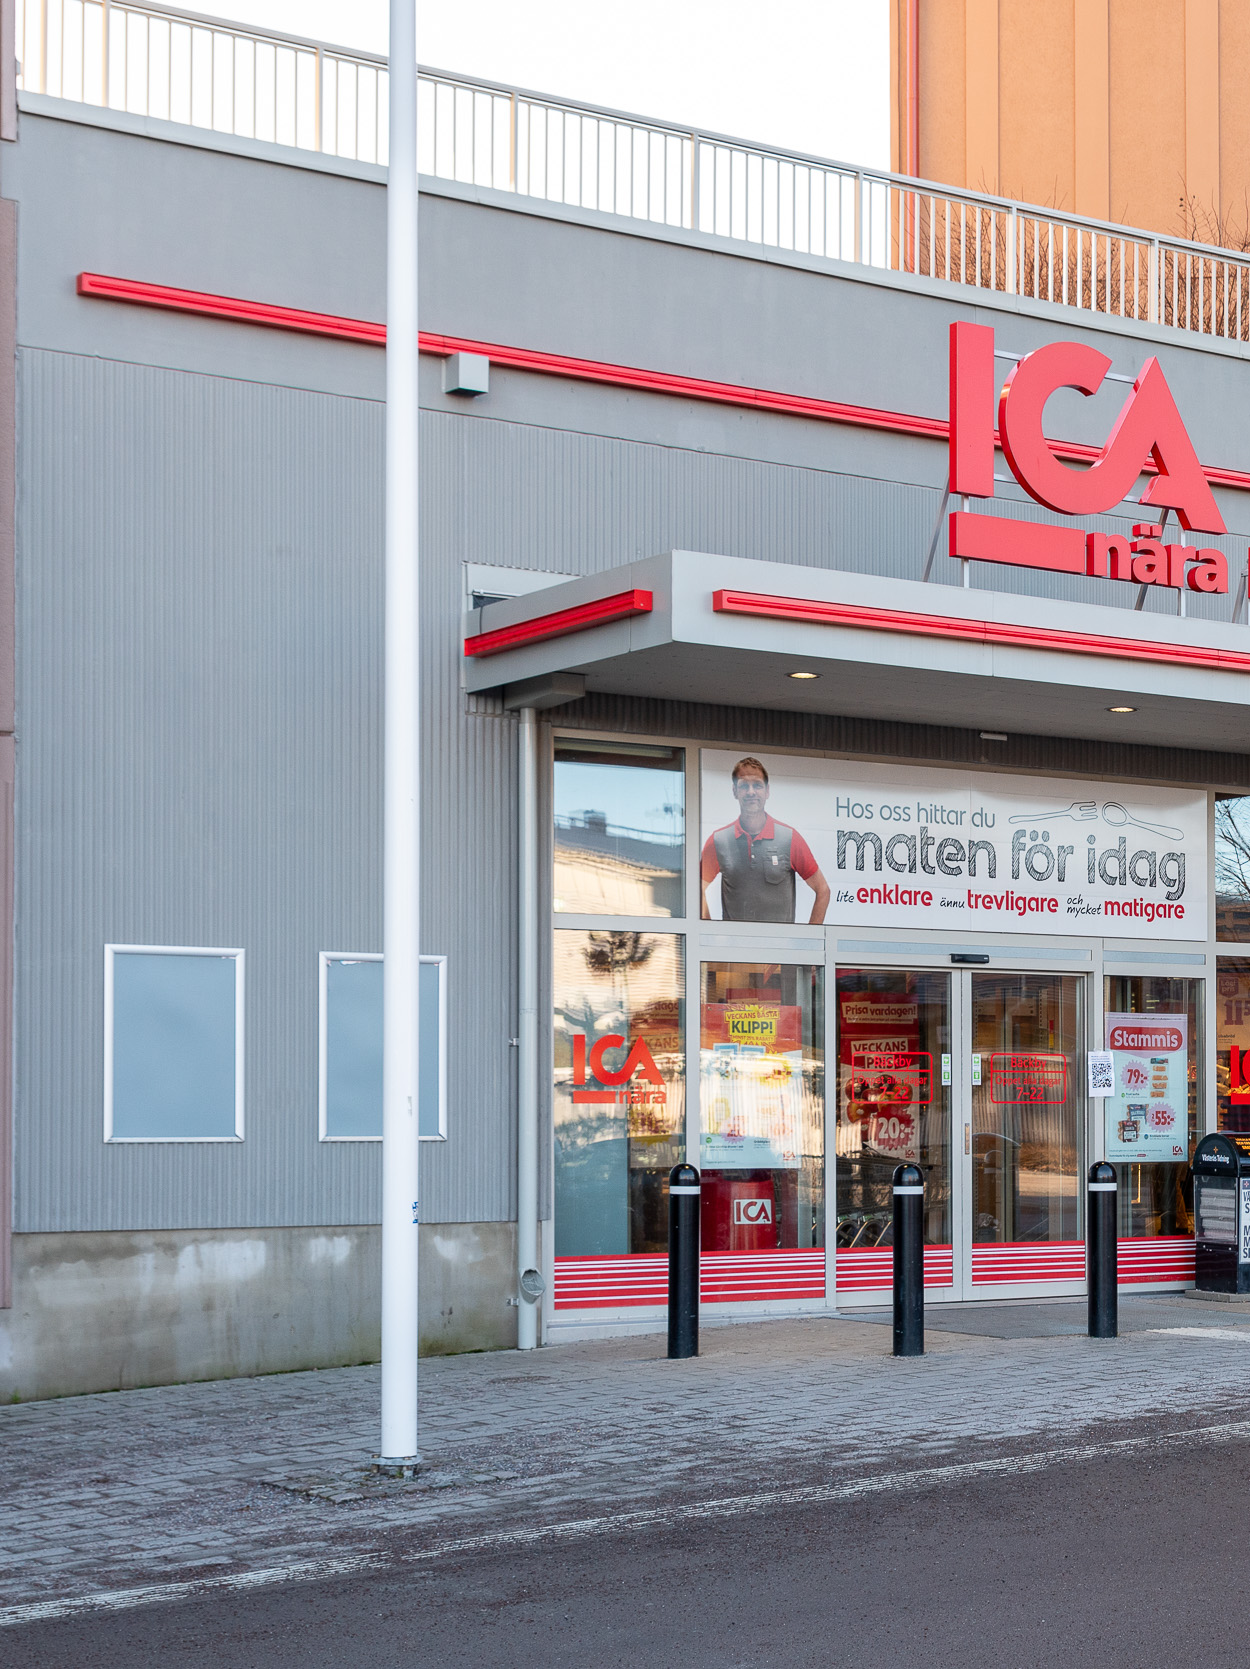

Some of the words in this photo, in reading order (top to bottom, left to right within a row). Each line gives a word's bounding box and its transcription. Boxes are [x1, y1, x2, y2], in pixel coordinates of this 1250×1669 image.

[950, 322, 1227, 533] ICA
[1086, 525, 1229, 594] nära
[836, 797, 875, 820] Hos
[879, 805, 912, 823] oss
[916, 802, 966, 826] hittar
[971, 806, 996, 828] du
[836, 826, 997, 879] maten
[1011, 829, 1074, 882] för
[1086, 834, 1186, 901] idag
[836, 889, 854, 904] lite
[856, 883, 933, 906] enklare
[940, 896, 965, 909] ännu
[967, 889, 1059, 916] trevligare
[1067, 894, 1084, 905] och
[1066, 903, 1102, 918] mycket
[1104, 898, 1185, 922] matigare
[726, 1012, 756, 1020] VECKANS
[845, 1005, 868, 1015] Prisa
[869, 1005, 916, 1018] vardagen!
[732, 1020, 773, 1034] KLIPP!
[853, 1041, 906, 1053] VECKANS
[1114, 1029, 1179, 1048] Stammis
[573, 1034, 666, 1086] ICA
[873, 1054, 912, 1071] Bäckby
[1010, 1057, 1047, 1071] Bäckby
[857, 1074, 887, 1087] Öppet
[887, 1075, 902, 1085] alla
[902, 1075, 928, 1087] dagar
[995, 1074, 1022, 1087] Öppet
[1023, 1075, 1038, 1085] alla
[1039, 1076, 1062, 1087] dagar
[1127, 1069, 1148, 1084] 79:-
[618, 1086, 667, 1105] nära
[1155, 1110, 1175, 1126] 55:-
[878, 1117, 911, 1139] 20:-
[1172, 1145, 1183, 1153] ICA
[735, 1201, 771, 1223] ICA
